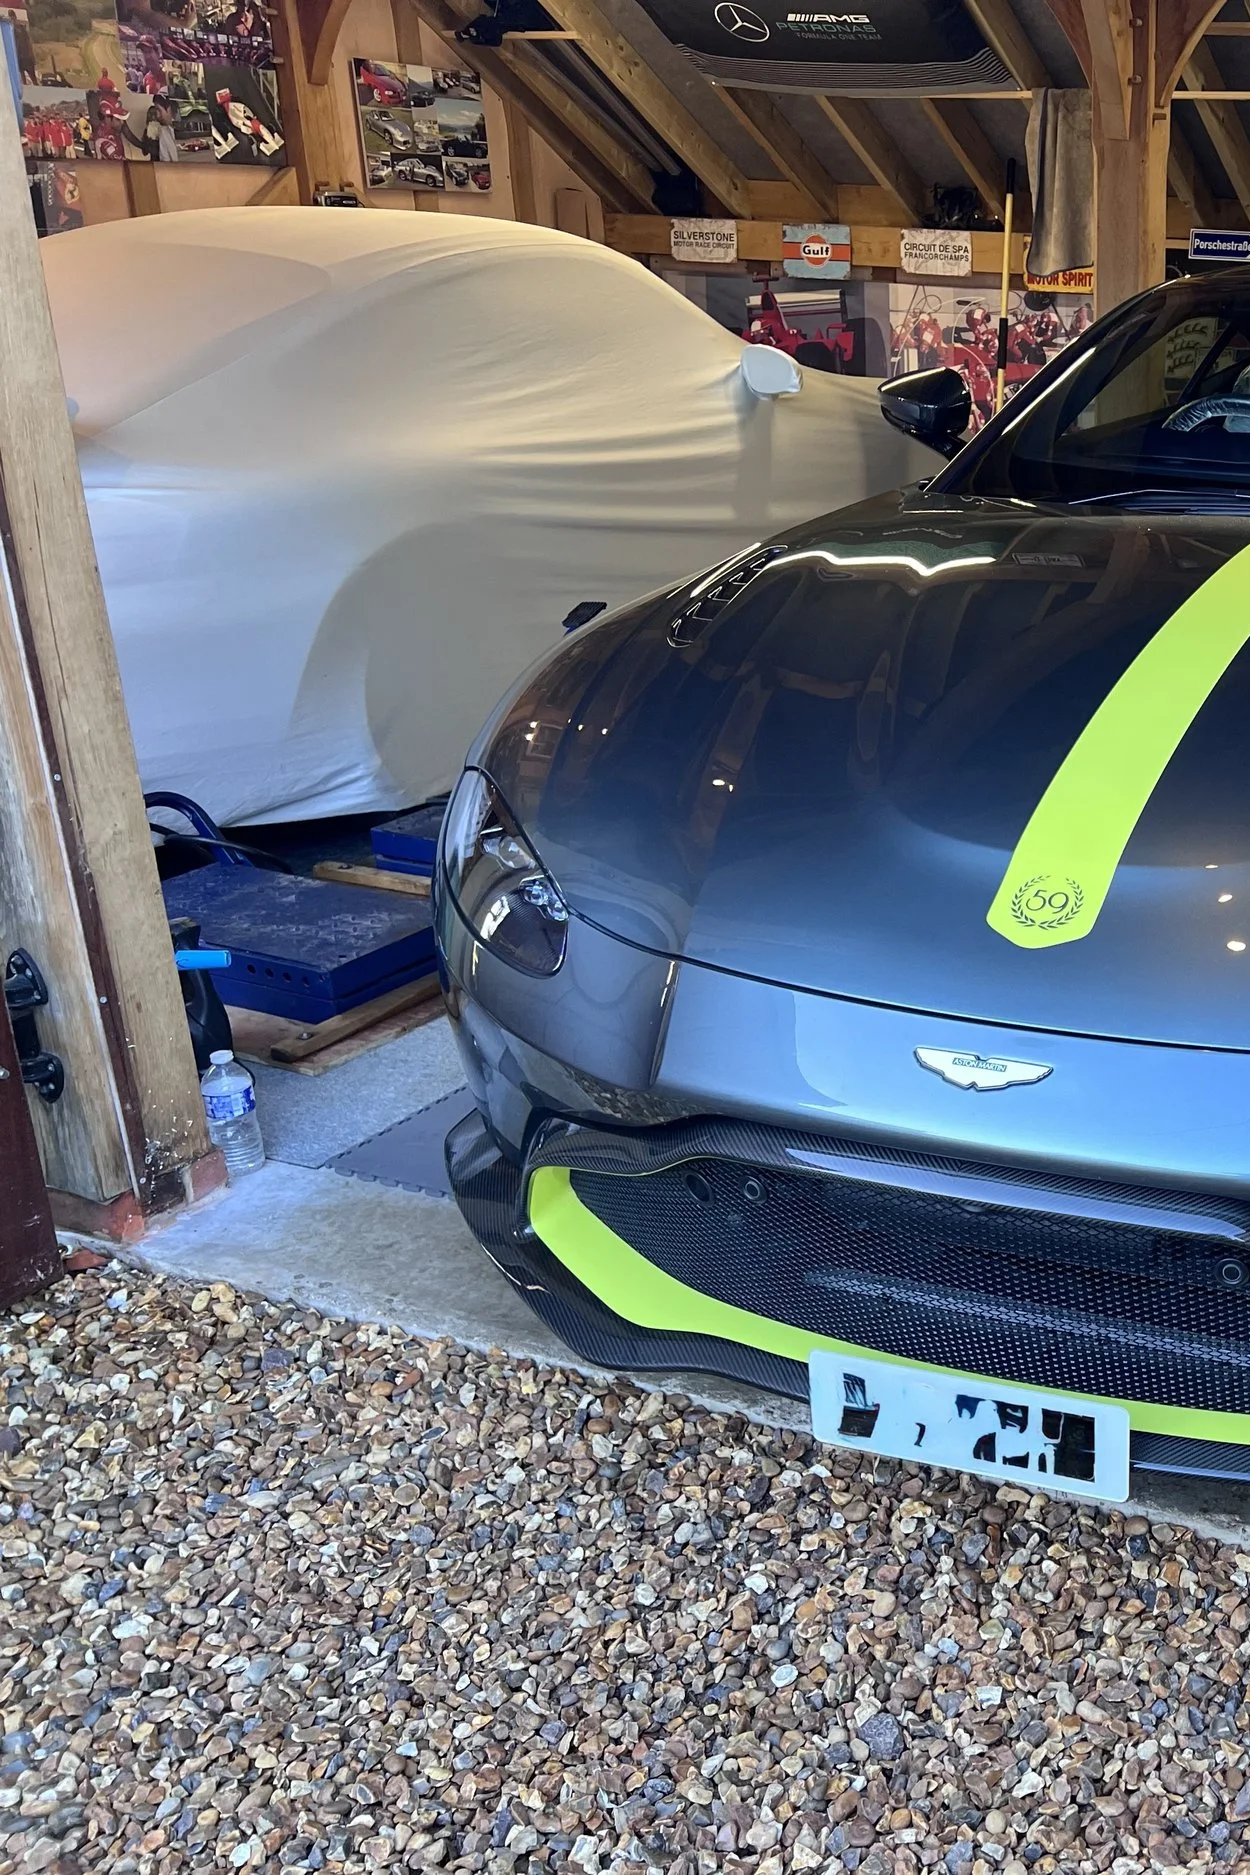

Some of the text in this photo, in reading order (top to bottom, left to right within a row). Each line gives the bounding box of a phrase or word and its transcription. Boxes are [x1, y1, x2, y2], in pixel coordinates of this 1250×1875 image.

[812, 13, 870, 23] AMG
[775, 21, 877, 33] PETRONAS
[797, 32, 882, 41] FORMULA ONE TEAM
[673, 230, 735, 242] SILVERSTONE
[694, 241, 711, 249] RACE
[712, 242, 735, 250] CIRCUIT
[802, 244, 830, 256] Gulf
[903, 242, 969, 254] CIRCUIT DE SPA
[904, 252, 969, 262] FRANCORCHAMPS
[1062, 271, 1094, 287] SPIRIT
[1025, 889, 1069, 914] 59
[953, 1058, 1007, 1072] ASTON MARTIN
